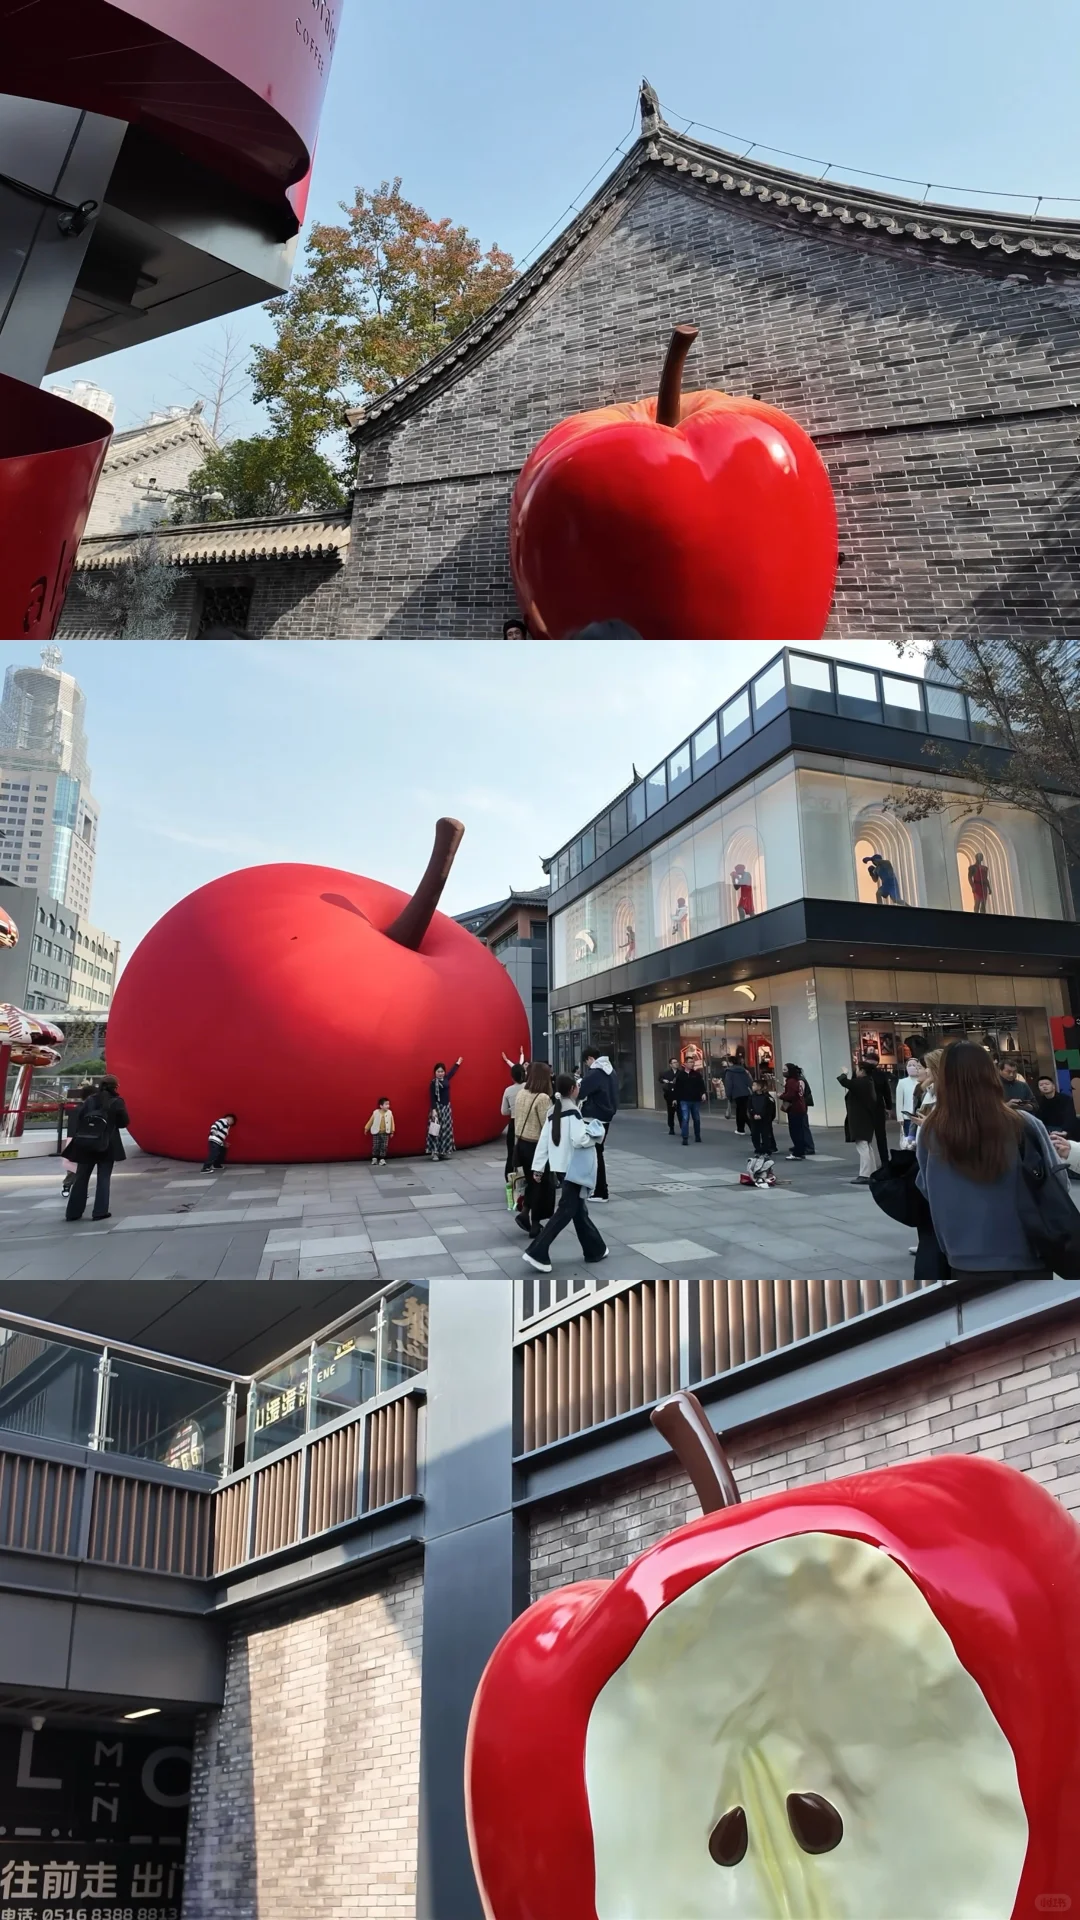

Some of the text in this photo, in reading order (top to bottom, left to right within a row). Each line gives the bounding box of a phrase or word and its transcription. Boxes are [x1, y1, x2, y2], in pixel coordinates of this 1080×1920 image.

[295, 17, 324, 77] COFFEE
[658, 1002, 675, 1018] ANTA
[300, 1364, 335, 1393] SENE
[94, 1741, 123, 1767] M
[92, 1797, 118, 1822] N
[0, 1860, 117, 1899] 往前走
[42, 1909, 87, 1920] 0516
